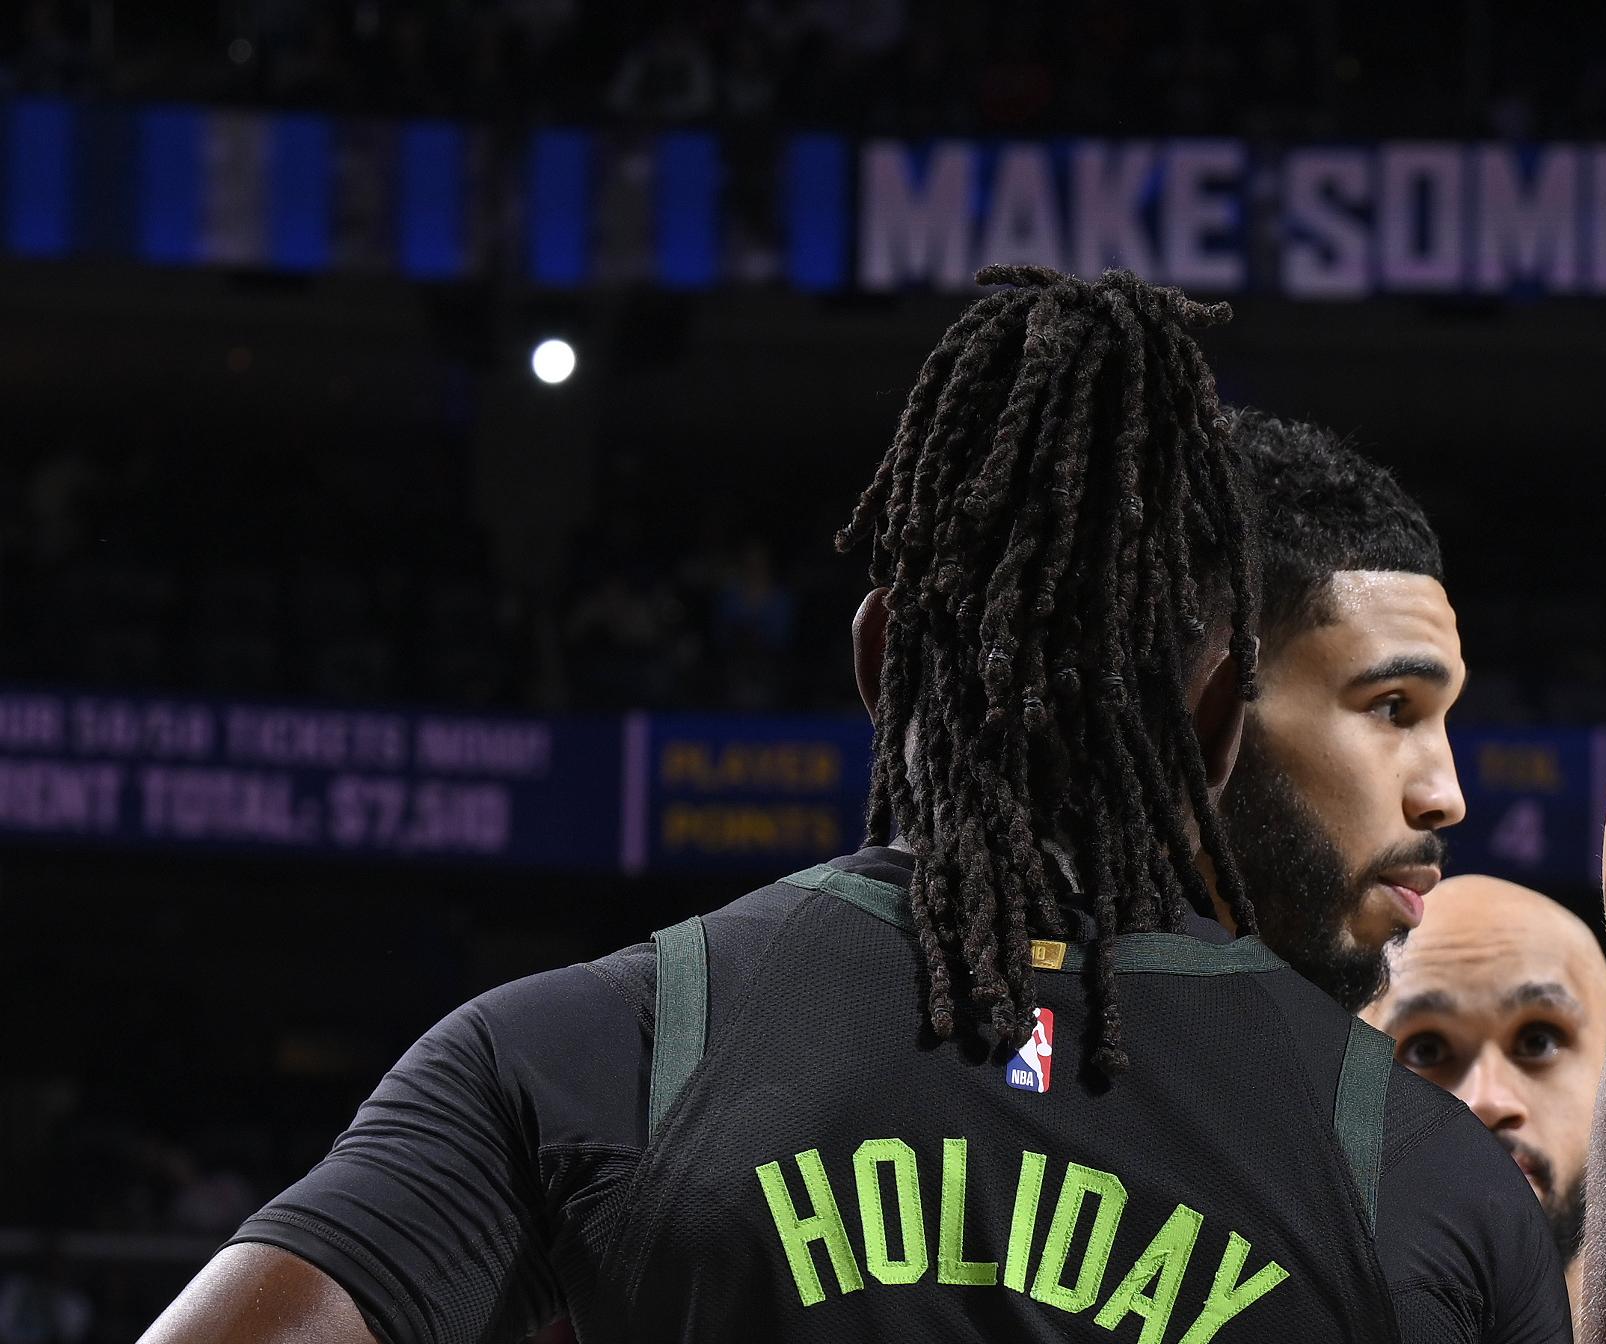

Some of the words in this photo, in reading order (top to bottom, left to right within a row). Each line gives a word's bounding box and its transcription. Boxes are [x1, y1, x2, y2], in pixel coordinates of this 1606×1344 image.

[858, 138, 1248, 292] MAKE
[225, 707, 403, 767] TICKETS
[662, 742, 841, 791] PLAYER
[1492, 800, 1545, 864] 4
[1011, 1069, 1034, 1087] NBA
